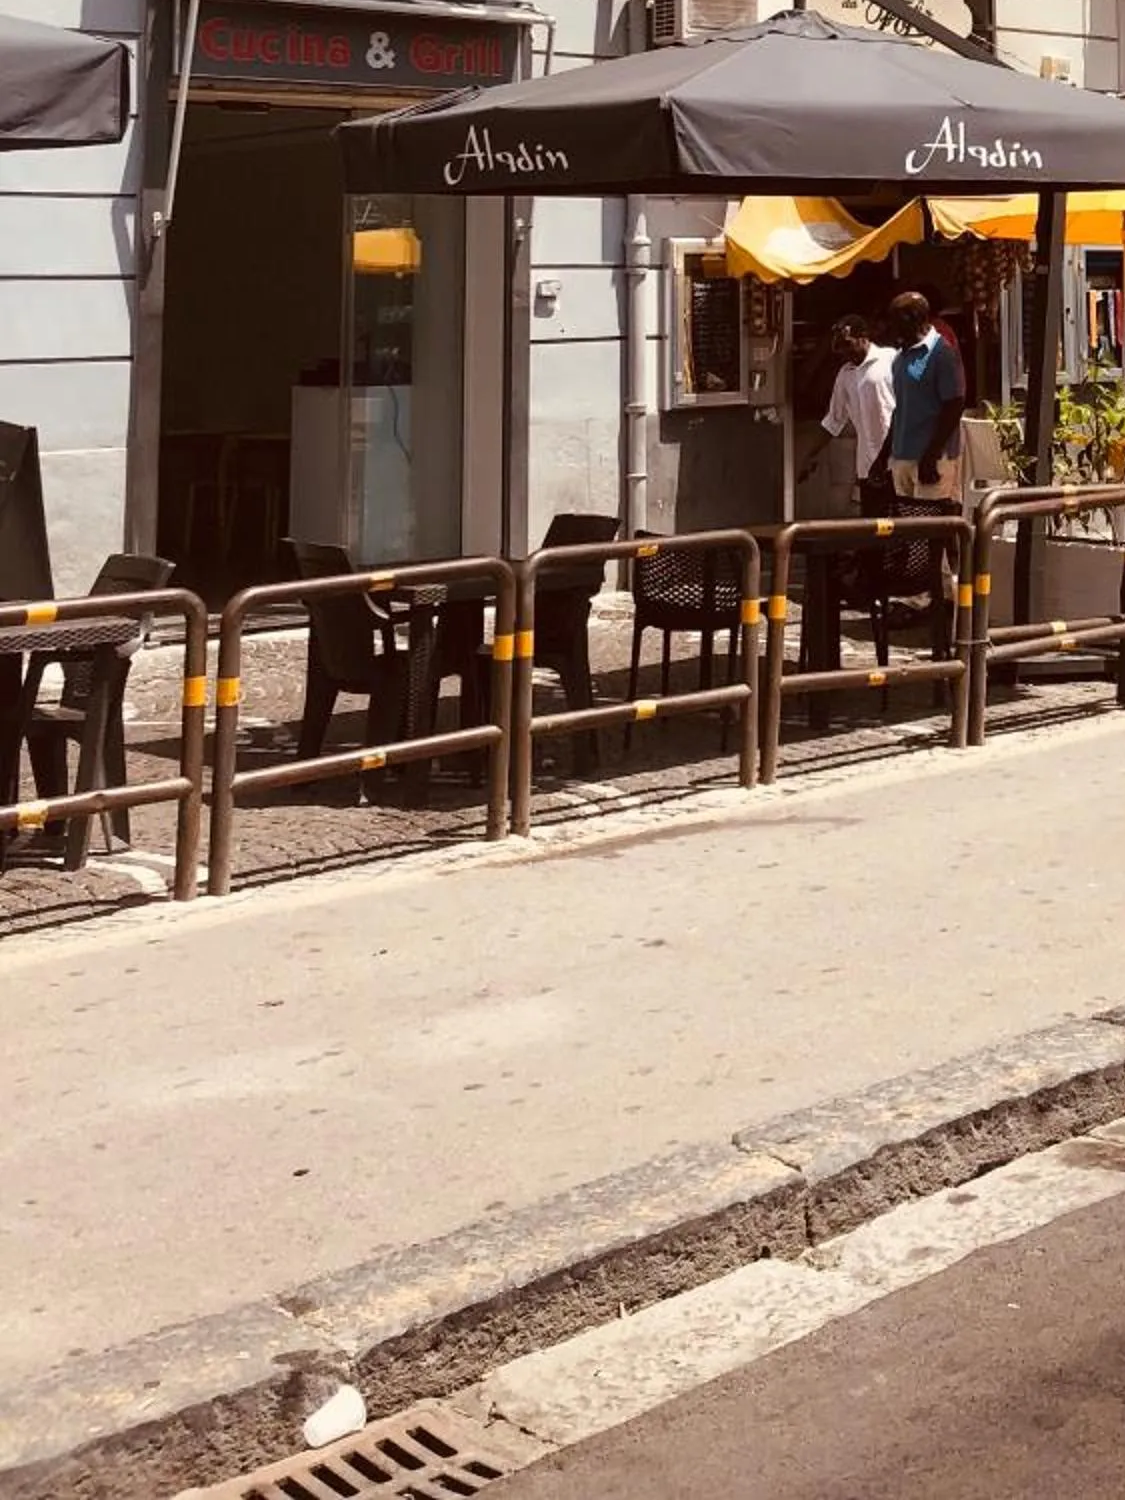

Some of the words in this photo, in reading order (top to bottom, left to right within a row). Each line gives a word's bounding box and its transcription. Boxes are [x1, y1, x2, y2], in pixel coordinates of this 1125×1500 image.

[200, 16, 350, 68] Cucina
[365, 31, 396, 70] &
[409, 32, 504, 77] Grill
[443, 124, 569, 186] Aladin
[905, 115, 1044, 175] Aladin
